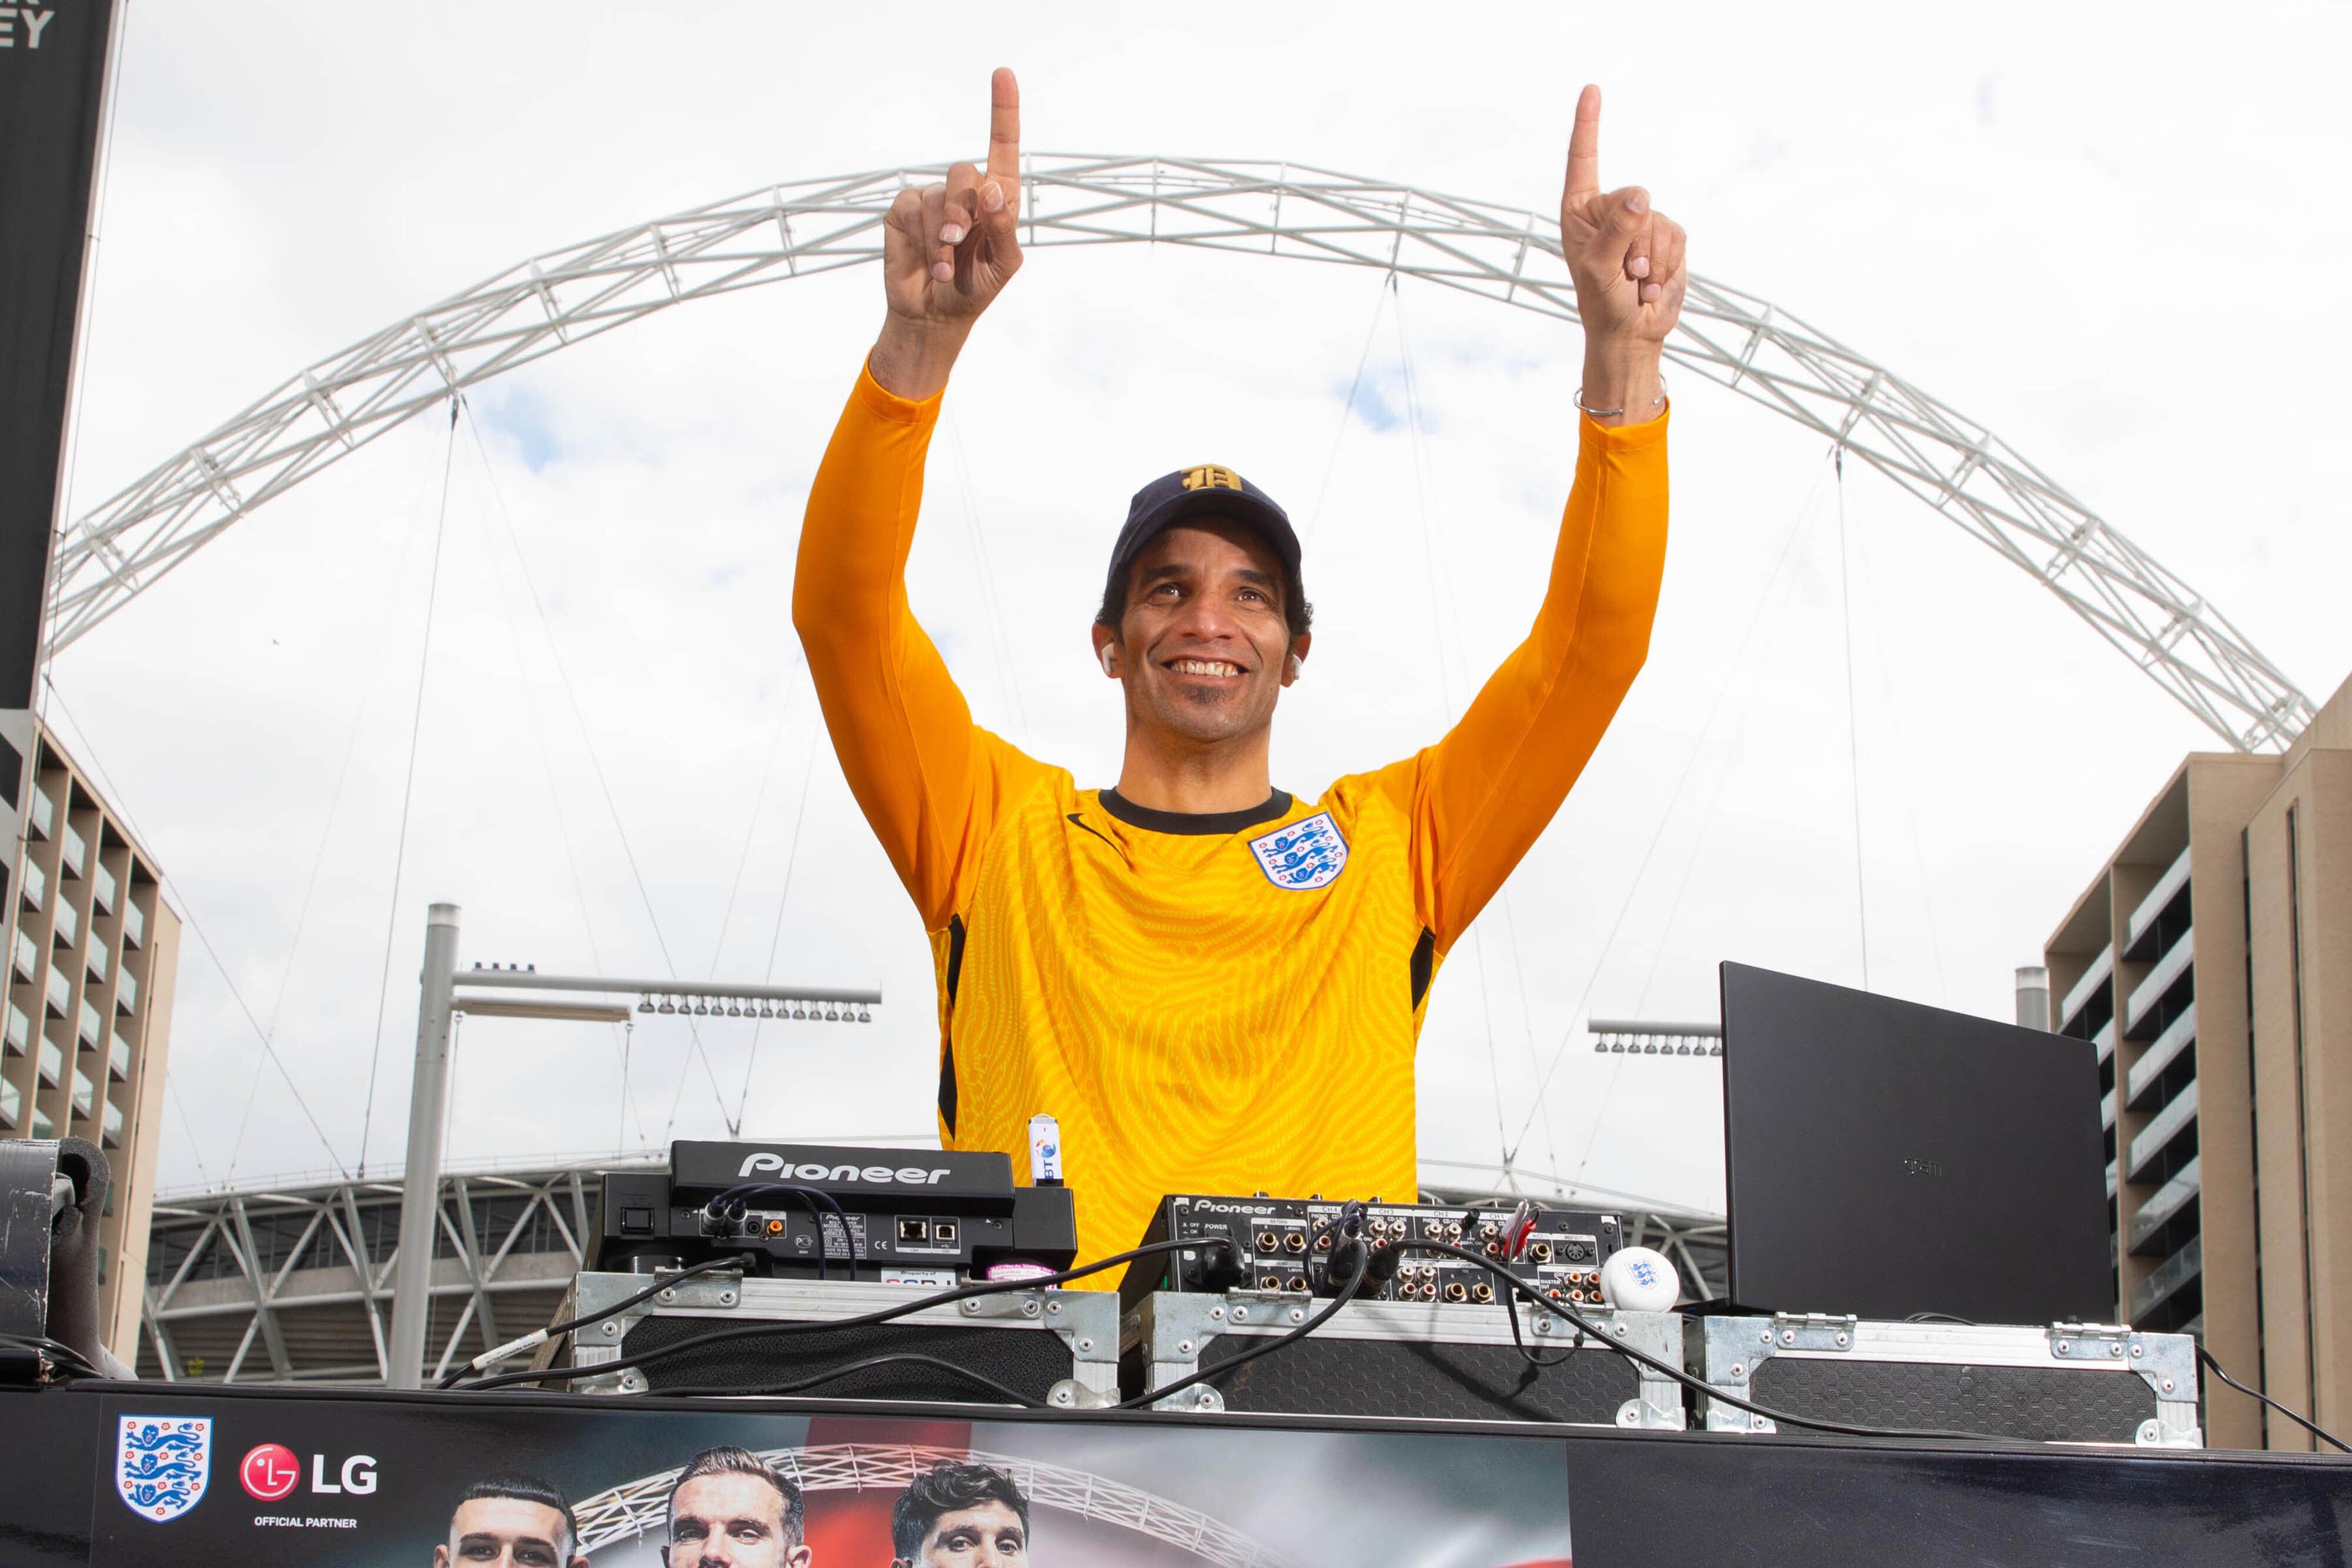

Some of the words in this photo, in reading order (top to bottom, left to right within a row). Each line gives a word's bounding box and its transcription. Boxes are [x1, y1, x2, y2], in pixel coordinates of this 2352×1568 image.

[738, 1153, 951, 1184] Pioneer
[1043, 1159, 1054, 1179] BT
[1903, 1158, 1942, 1176] gram
[1194, 1199, 1276, 1215] Pioneer
[874, 1241, 887, 1250] CE
[311, 1454, 377, 1495] LG
[254, 1516, 303, 1527] OFFICIAL
[305, 1517, 357, 1529] PARTNER
